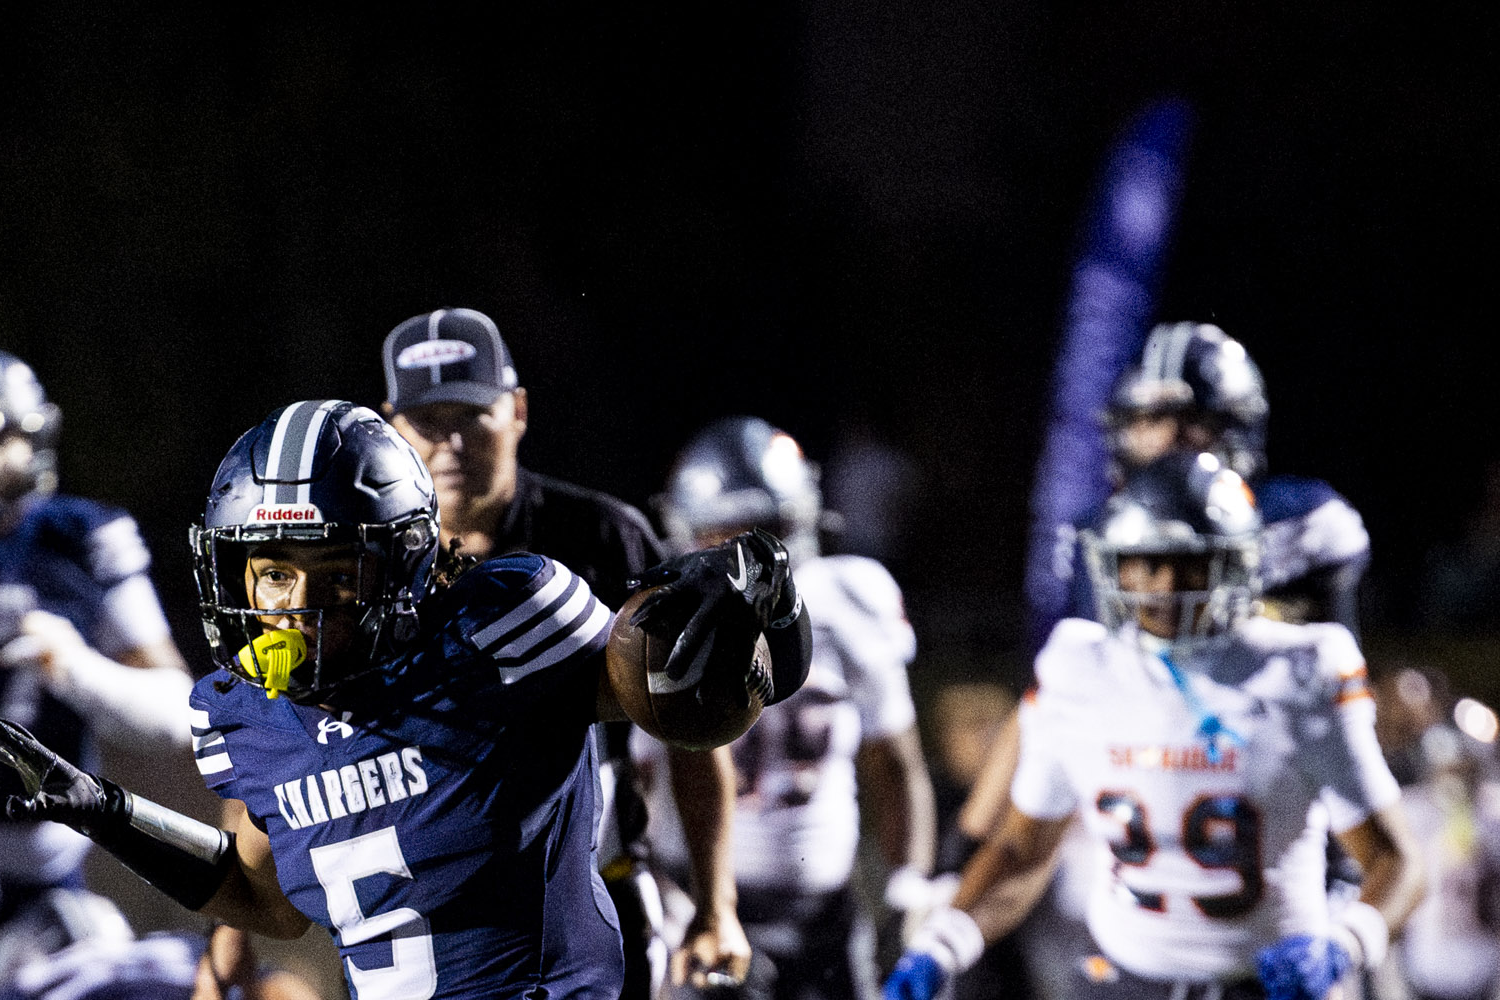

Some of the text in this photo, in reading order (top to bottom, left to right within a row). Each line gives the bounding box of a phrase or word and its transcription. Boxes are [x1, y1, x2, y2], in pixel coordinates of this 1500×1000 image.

[256, 508, 316, 521] Riddell
[274, 746, 429, 831] CHARGERS
[1095, 788, 1266, 922] 29
